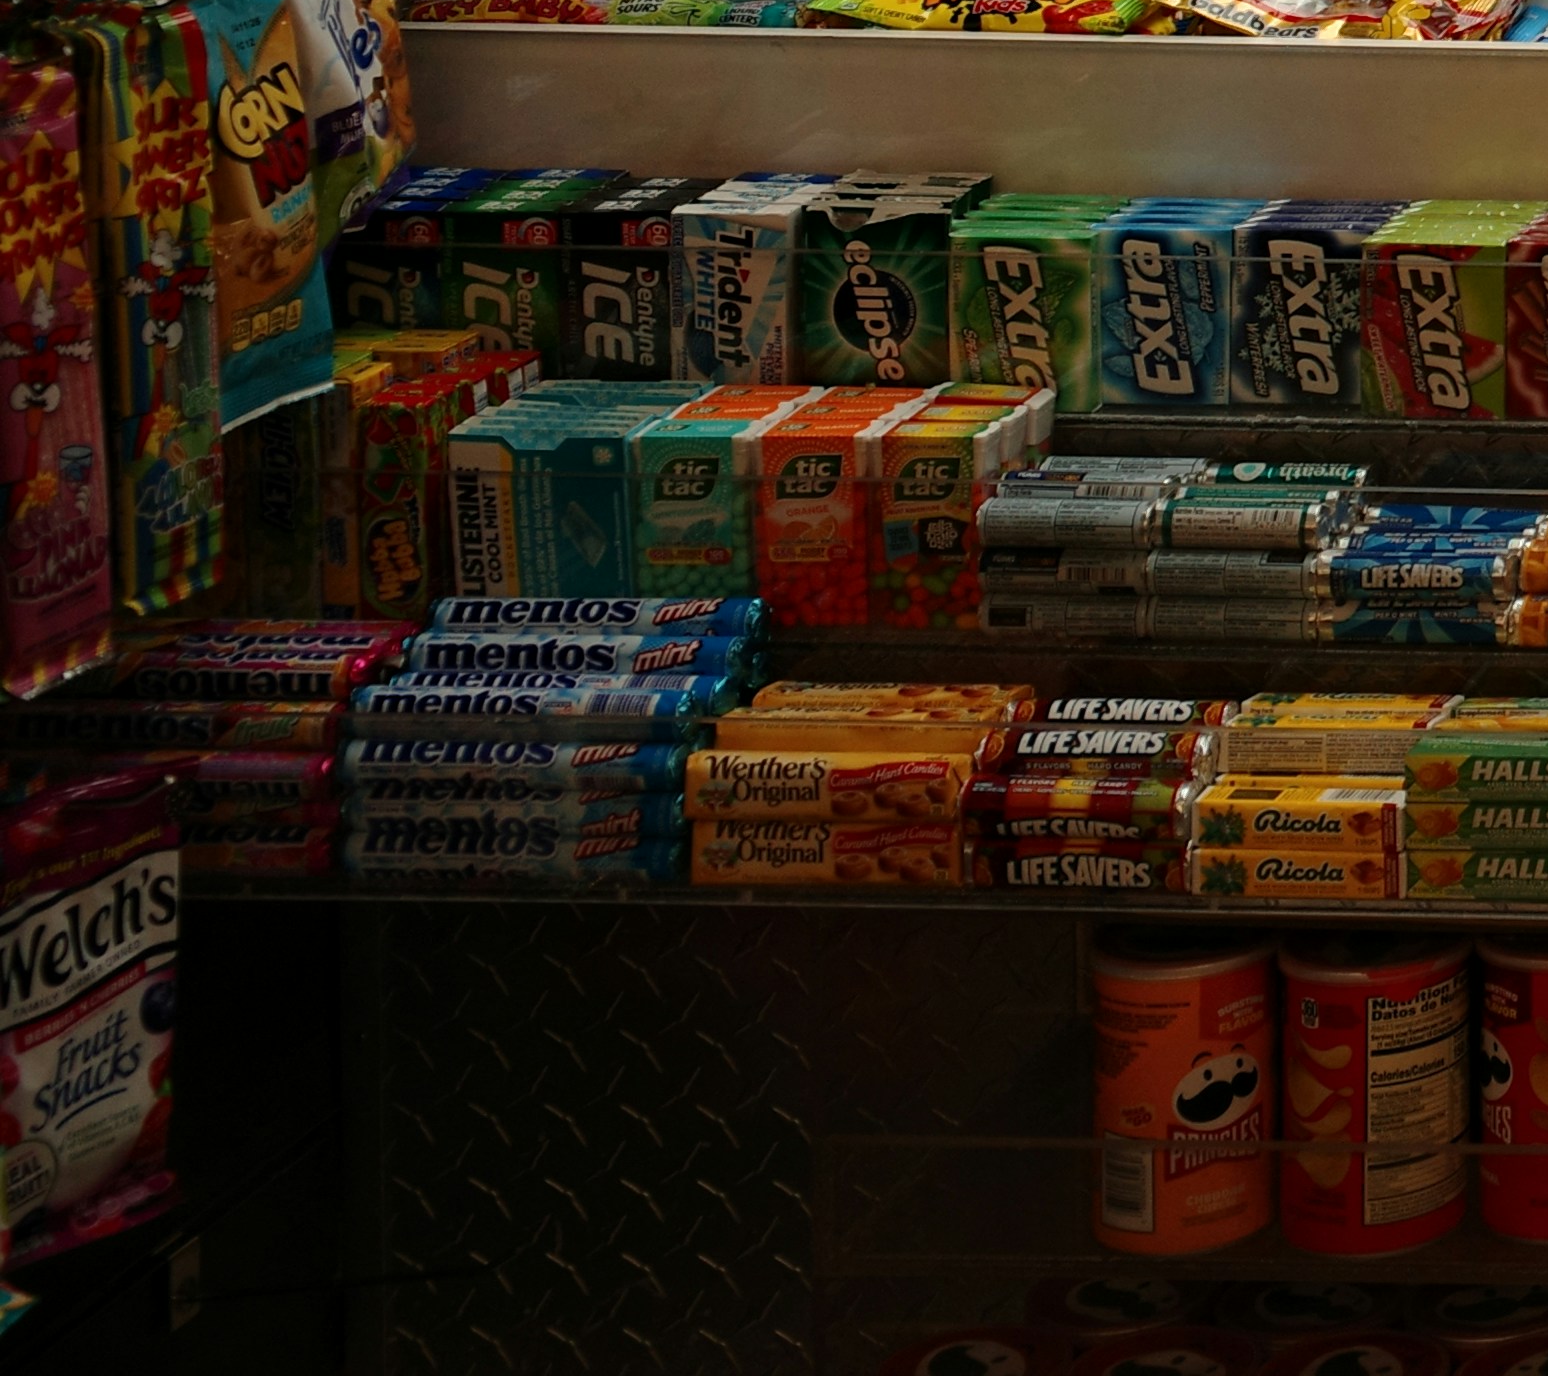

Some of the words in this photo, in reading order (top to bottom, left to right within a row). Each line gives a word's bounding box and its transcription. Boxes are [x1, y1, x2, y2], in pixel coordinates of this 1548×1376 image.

[715, 227, 753, 368] Trident
[843, 240, 905, 383] eclipse
[1120, 238, 1195, 397] Extra
[1267, 238, 1340, 397] Extra
[1396, 253, 1472, 411] Extra
[672, 459, 709, 480] tic
[795, 457, 831, 479] tic
[912, 459, 950, 480] tic
[661, 477, 708, 499] tac
[782, 479, 832, 499] tac
[903, 479, 949, 500] tac
[456, 466, 481, 596] LISTERINE
[446, 599, 642, 624] mentos
[652, 596, 724, 625] mint
[426, 638, 616, 672] mentos
[633, 639, 702, 673] mint
[1048, 699, 1098, 722] LIFE
[1098, 698, 1195, 722] SAVERS
[704, 755, 826, 788] Werther's
[731, 779, 822, 804] Original
[1253, 809, 1342, 836] Ricola
[1006, 857, 1059, 887] LIFE
[1059, 857, 1151, 889] SAVERS
[1255, 859, 1344, 883] Ricola
[55, 1008, 129, 1066] Fruit
[34, 1046, 141, 1131] Snacks
